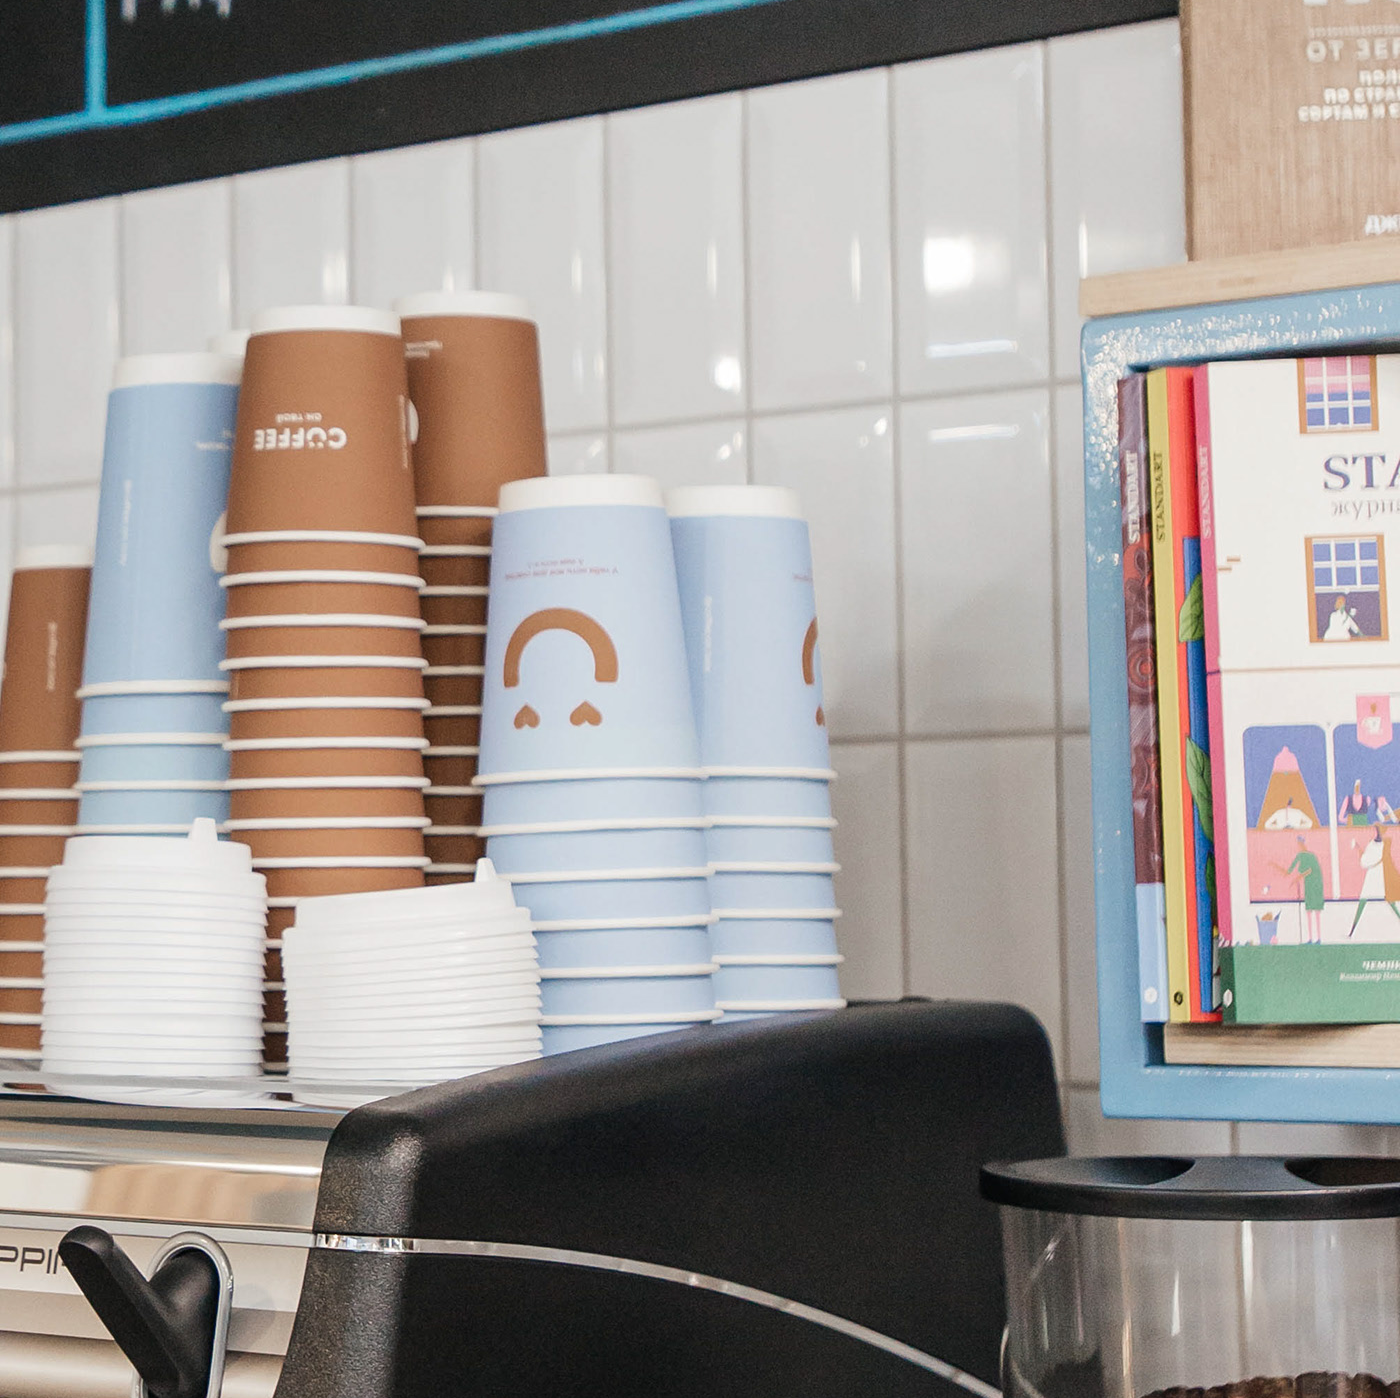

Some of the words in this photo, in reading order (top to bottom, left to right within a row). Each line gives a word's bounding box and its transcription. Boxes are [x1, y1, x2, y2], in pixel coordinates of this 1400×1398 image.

[1353, 86, 1400, 103] СТРА
[1359, 69, 1400, 86] ПОЛ
[1153, 450, 1165, 544] STANDART
[1199, 444, 1212, 540] STANDART
